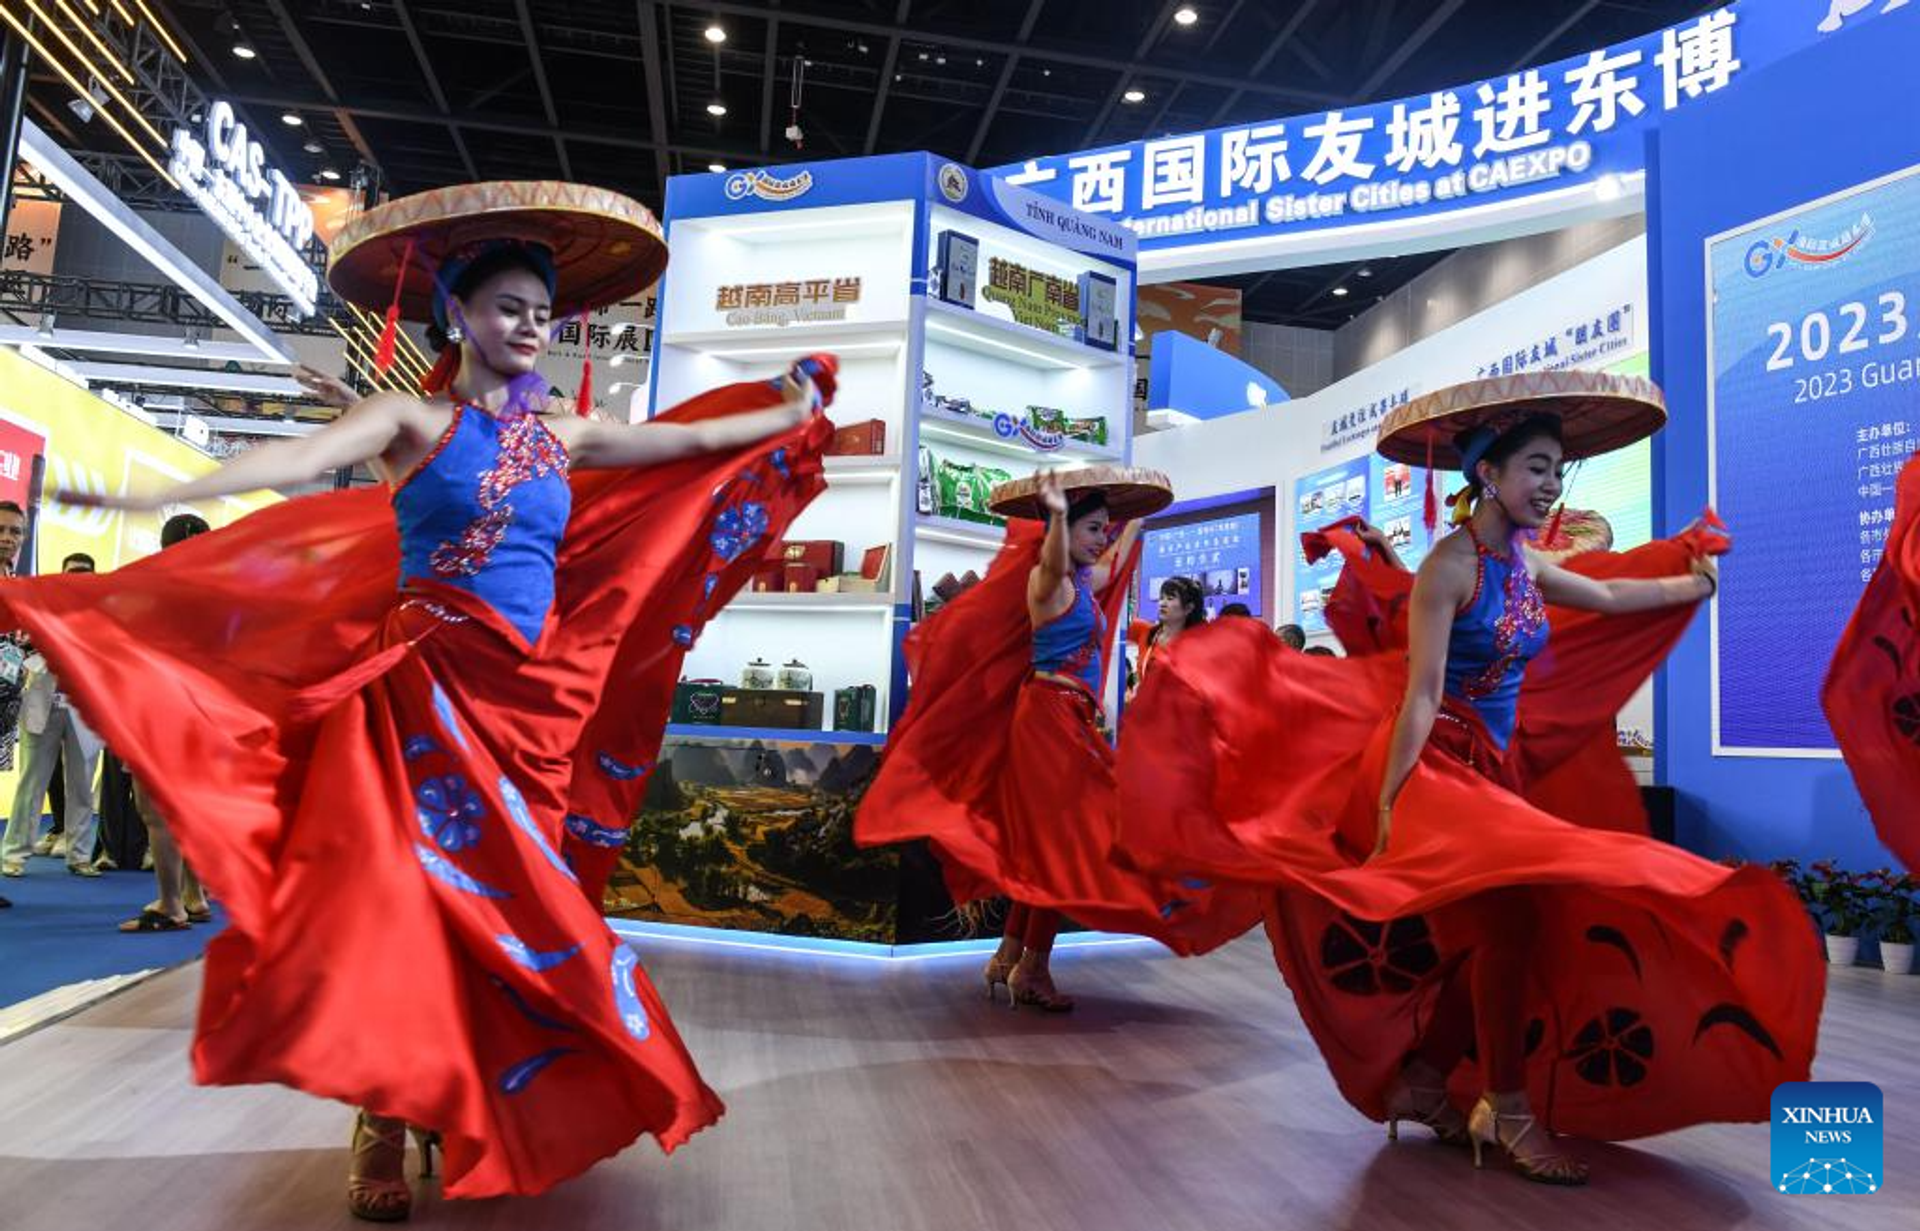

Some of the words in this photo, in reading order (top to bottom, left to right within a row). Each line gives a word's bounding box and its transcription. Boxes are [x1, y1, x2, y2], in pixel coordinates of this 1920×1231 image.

[1113, 199, 1259, 236] ternational
[1266, 191, 1347, 224] Sister
[1350, 180, 1431, 211] Cities
[1434, 170, 1467, 199] at
[1468, 141, 1591, 191] CAEXPO
[1099, 230, 1123, 250] NAM
[716, 277, 860, 311] 越南高平省
[989, 256, 1079, 312] 越南广南省
[1766, 291, 1920, 371] 2023
[1794, 368, 1852, 404] 2023
